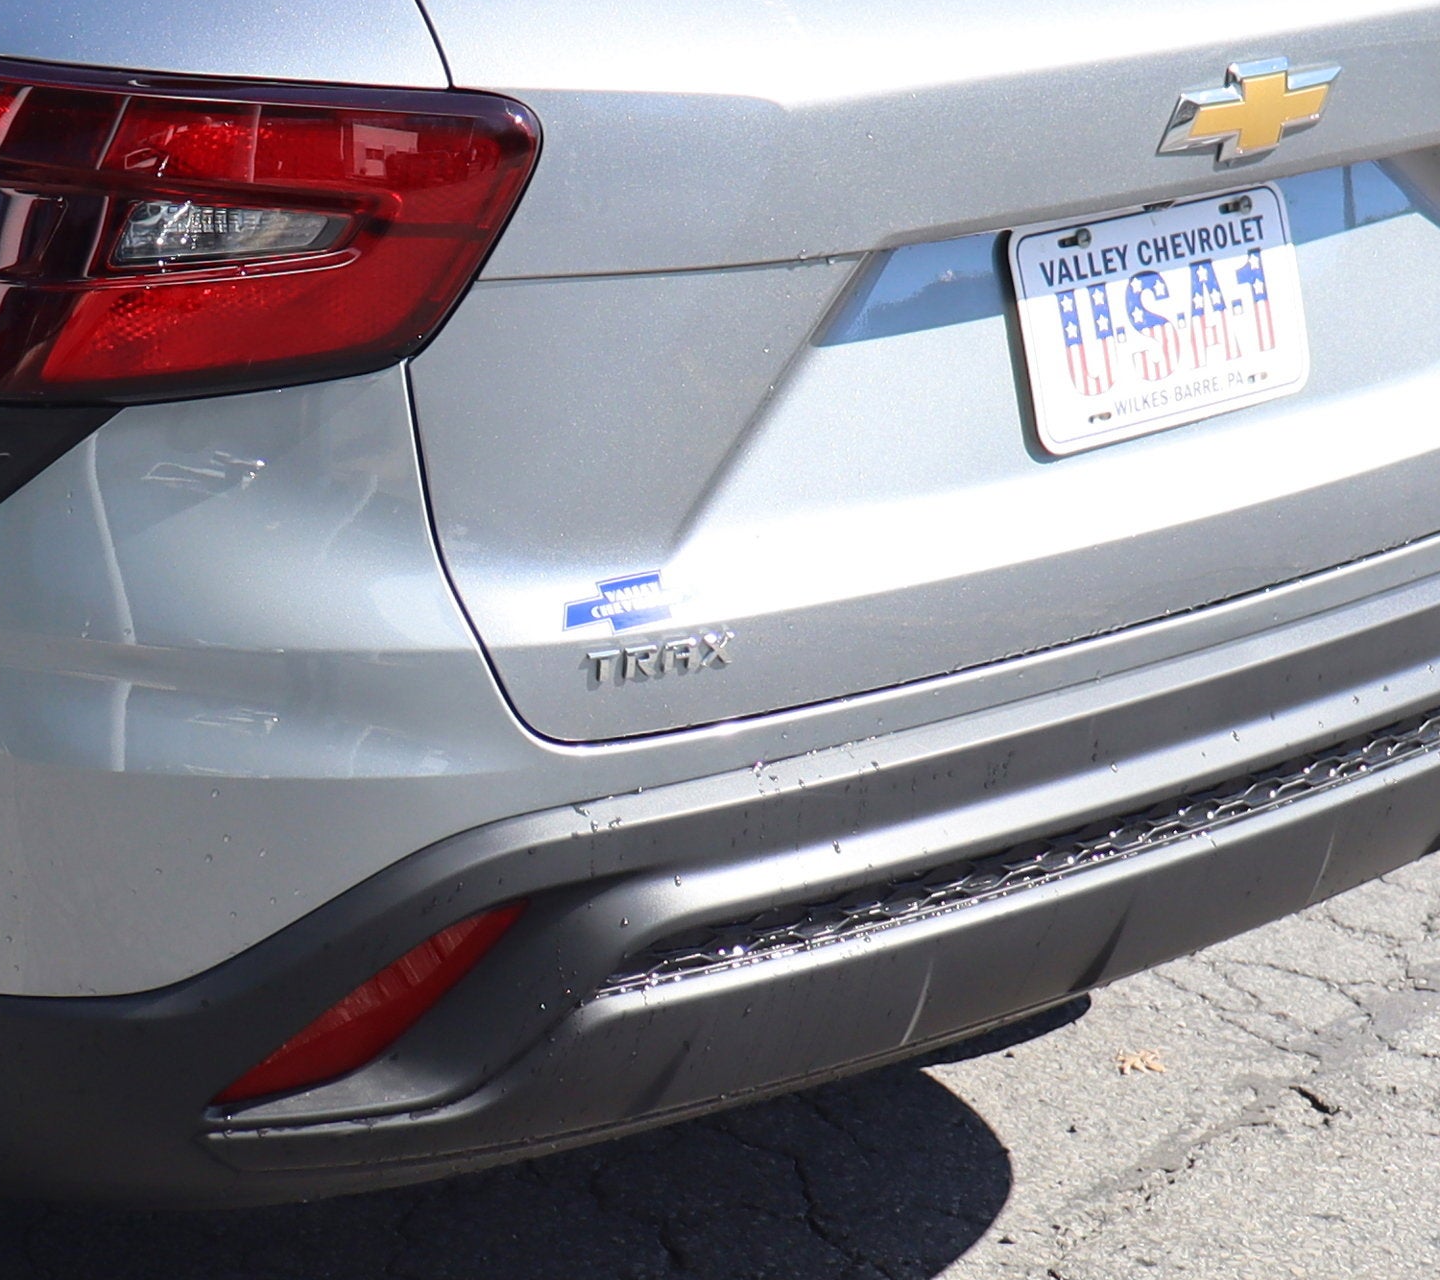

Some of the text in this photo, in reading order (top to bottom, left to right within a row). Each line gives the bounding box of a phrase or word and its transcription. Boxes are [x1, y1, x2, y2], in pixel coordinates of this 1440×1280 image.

[1039, 215, 1265, 287] VALLEY CHEVROLET
[1228, 371, 1245, 388] PA
[586, 630, 736, 682] TRAX
